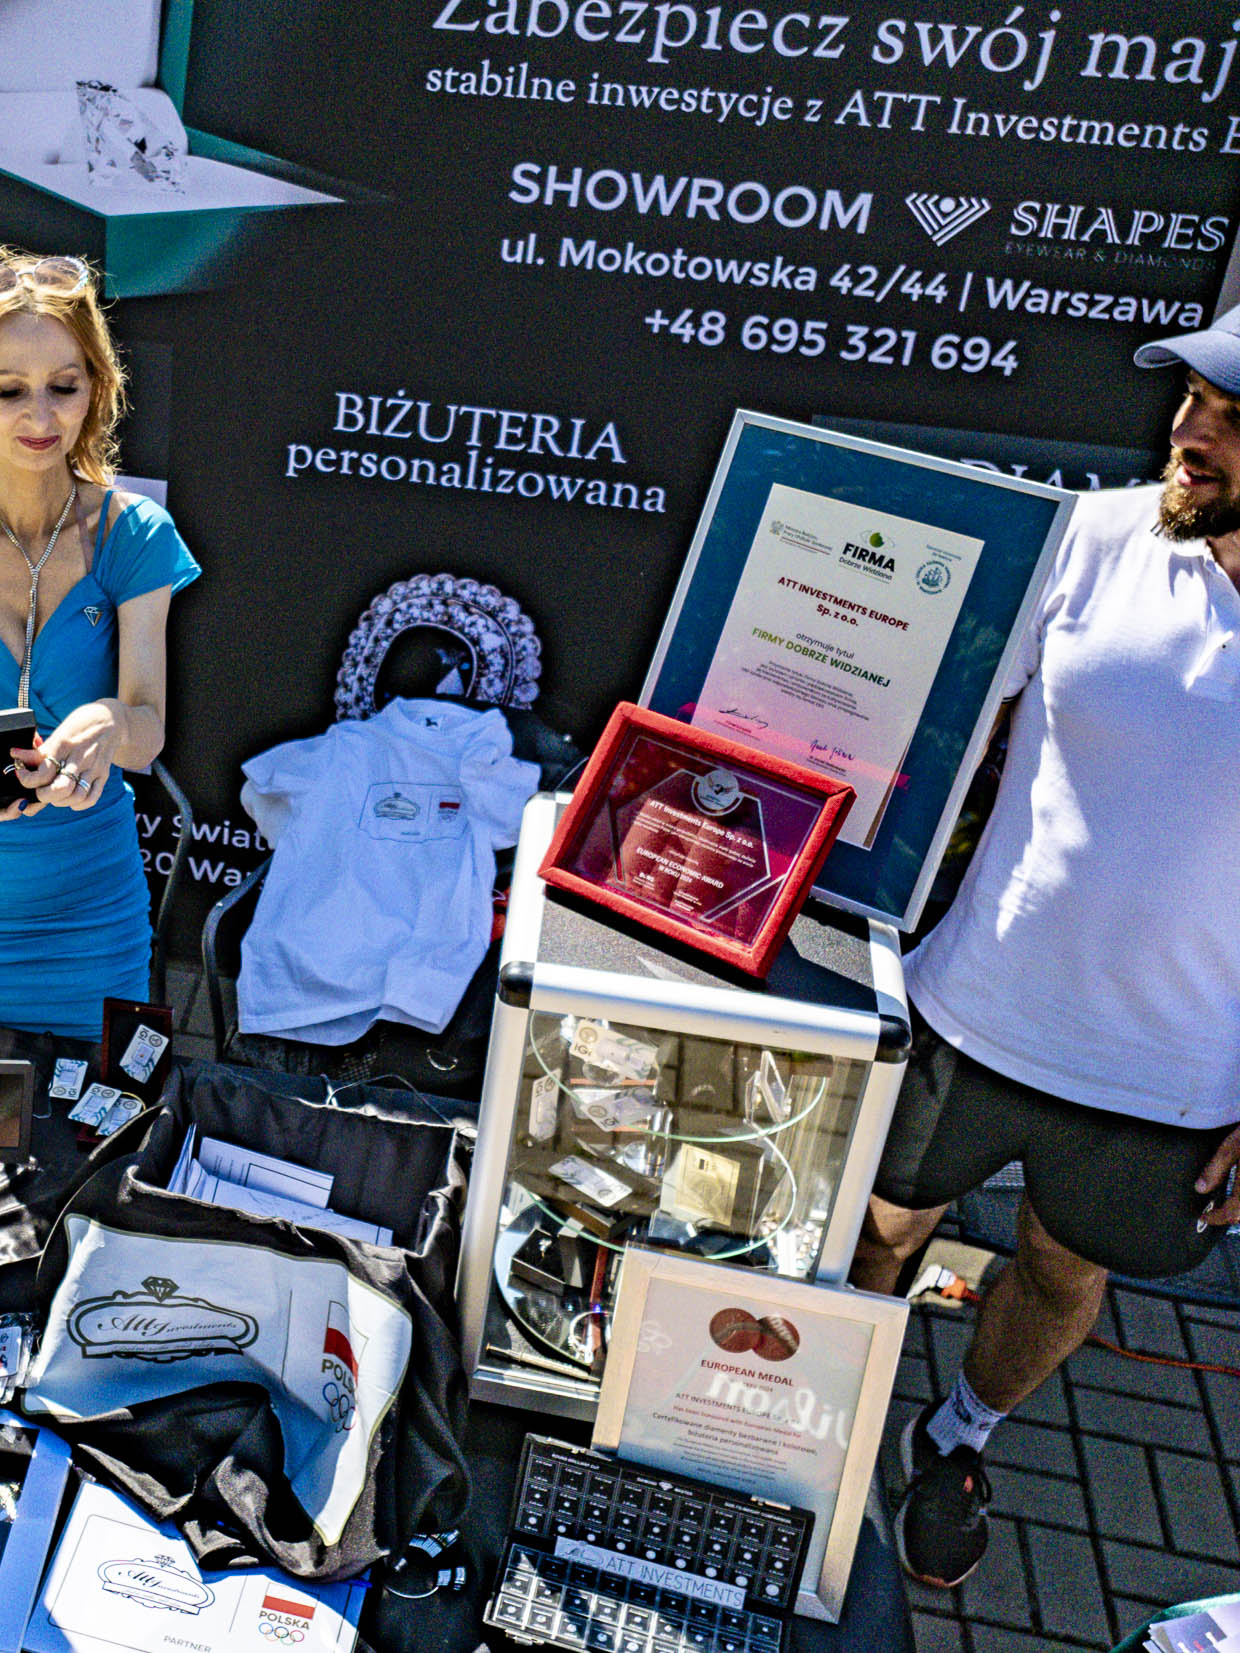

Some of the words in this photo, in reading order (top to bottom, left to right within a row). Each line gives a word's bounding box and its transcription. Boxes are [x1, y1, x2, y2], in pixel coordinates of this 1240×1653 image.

[871, 6, 1062, 92] swój
[425, 60, 576, 102] stabilne
[587, 72, 793, 127] inwestycje
[803, 99, 823, 124] z
[834, 88, 942, 132] ATT
[947, 97, 1209, 153] Investments
[507, 161, 874, 235] SHOWROOM
[1005, 241, 1085, 262] EYEWEAR
[1009, 200, 1230, 252] SHAPES
[500, 233, 545, 266] ul.
[558, 236, 819, 292] Mokotowska
[829, 263, 948, 304] 42/44
[985, 275, 1204, 329] Warszawa
[644, 308, 727, 347] +48
[741, 314, 828, 358] 695
[839, 324, 918, 367] 321
[930, 333, 1020, 378] 694
[333, 389, 628, 464] BIŻUTERIA
[286, 442, 667, 513] personalizowana
[838, 556, 862, 572] Dobrze
[842, 542, 896, 573] FIRMA
[777, 575, 798, 591] ATT
[798, 583, 868, 616] INVESTMENTS
[868, 608, 910, 632] EUROPE
[816, 603, 833, 617] Sp.
[833, 611, 840, 620] z
[841, 613, 859, 627] o.o.
[751, 627, 785, 648] FIRMY
[785, 641, 828, 665] DOBRZE
[829, 657, 891, 688] WIDZIANEJ
[796, 631, 835, 653] otrzymuje
[836, 644, 855, 660] tytuł
[649, 800, 664, 811] ATT
[701, 1359, 756, 1380] EUROPEAN
[757, 1372, 794, 1388] MEDAL
[607, 1555, 636, 1574] ATT
[639, 1564, 744, 1608] INVESTMENTS
[163, 1634, 212, 1653] PARTNER
[259, 1609, 310, 1631] POLSKA
